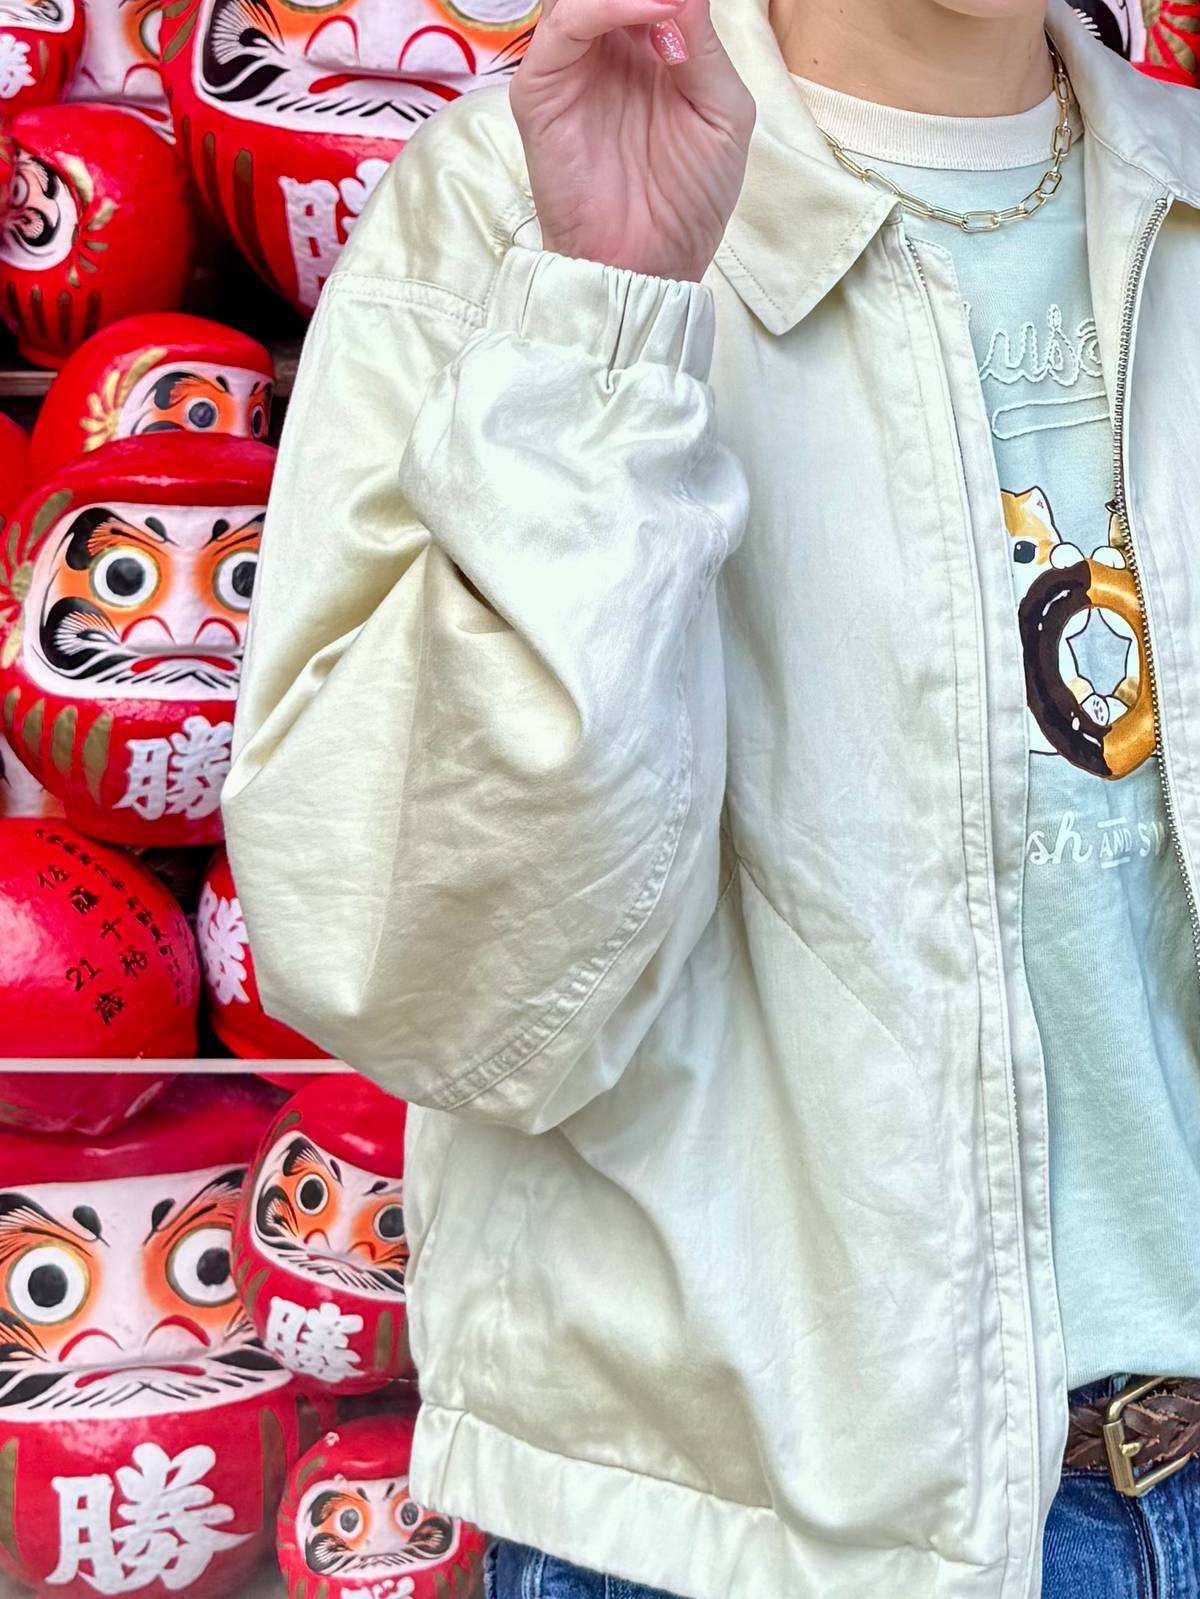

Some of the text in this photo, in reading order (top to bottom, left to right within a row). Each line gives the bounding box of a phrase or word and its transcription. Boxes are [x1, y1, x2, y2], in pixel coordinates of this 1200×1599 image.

[112, 716, 233, 820] 勝
[1099, 828, 1132, 858] AND
[265, 1296, 367, 1384] 勝
[45, 1441, 256, 1594] 勝
